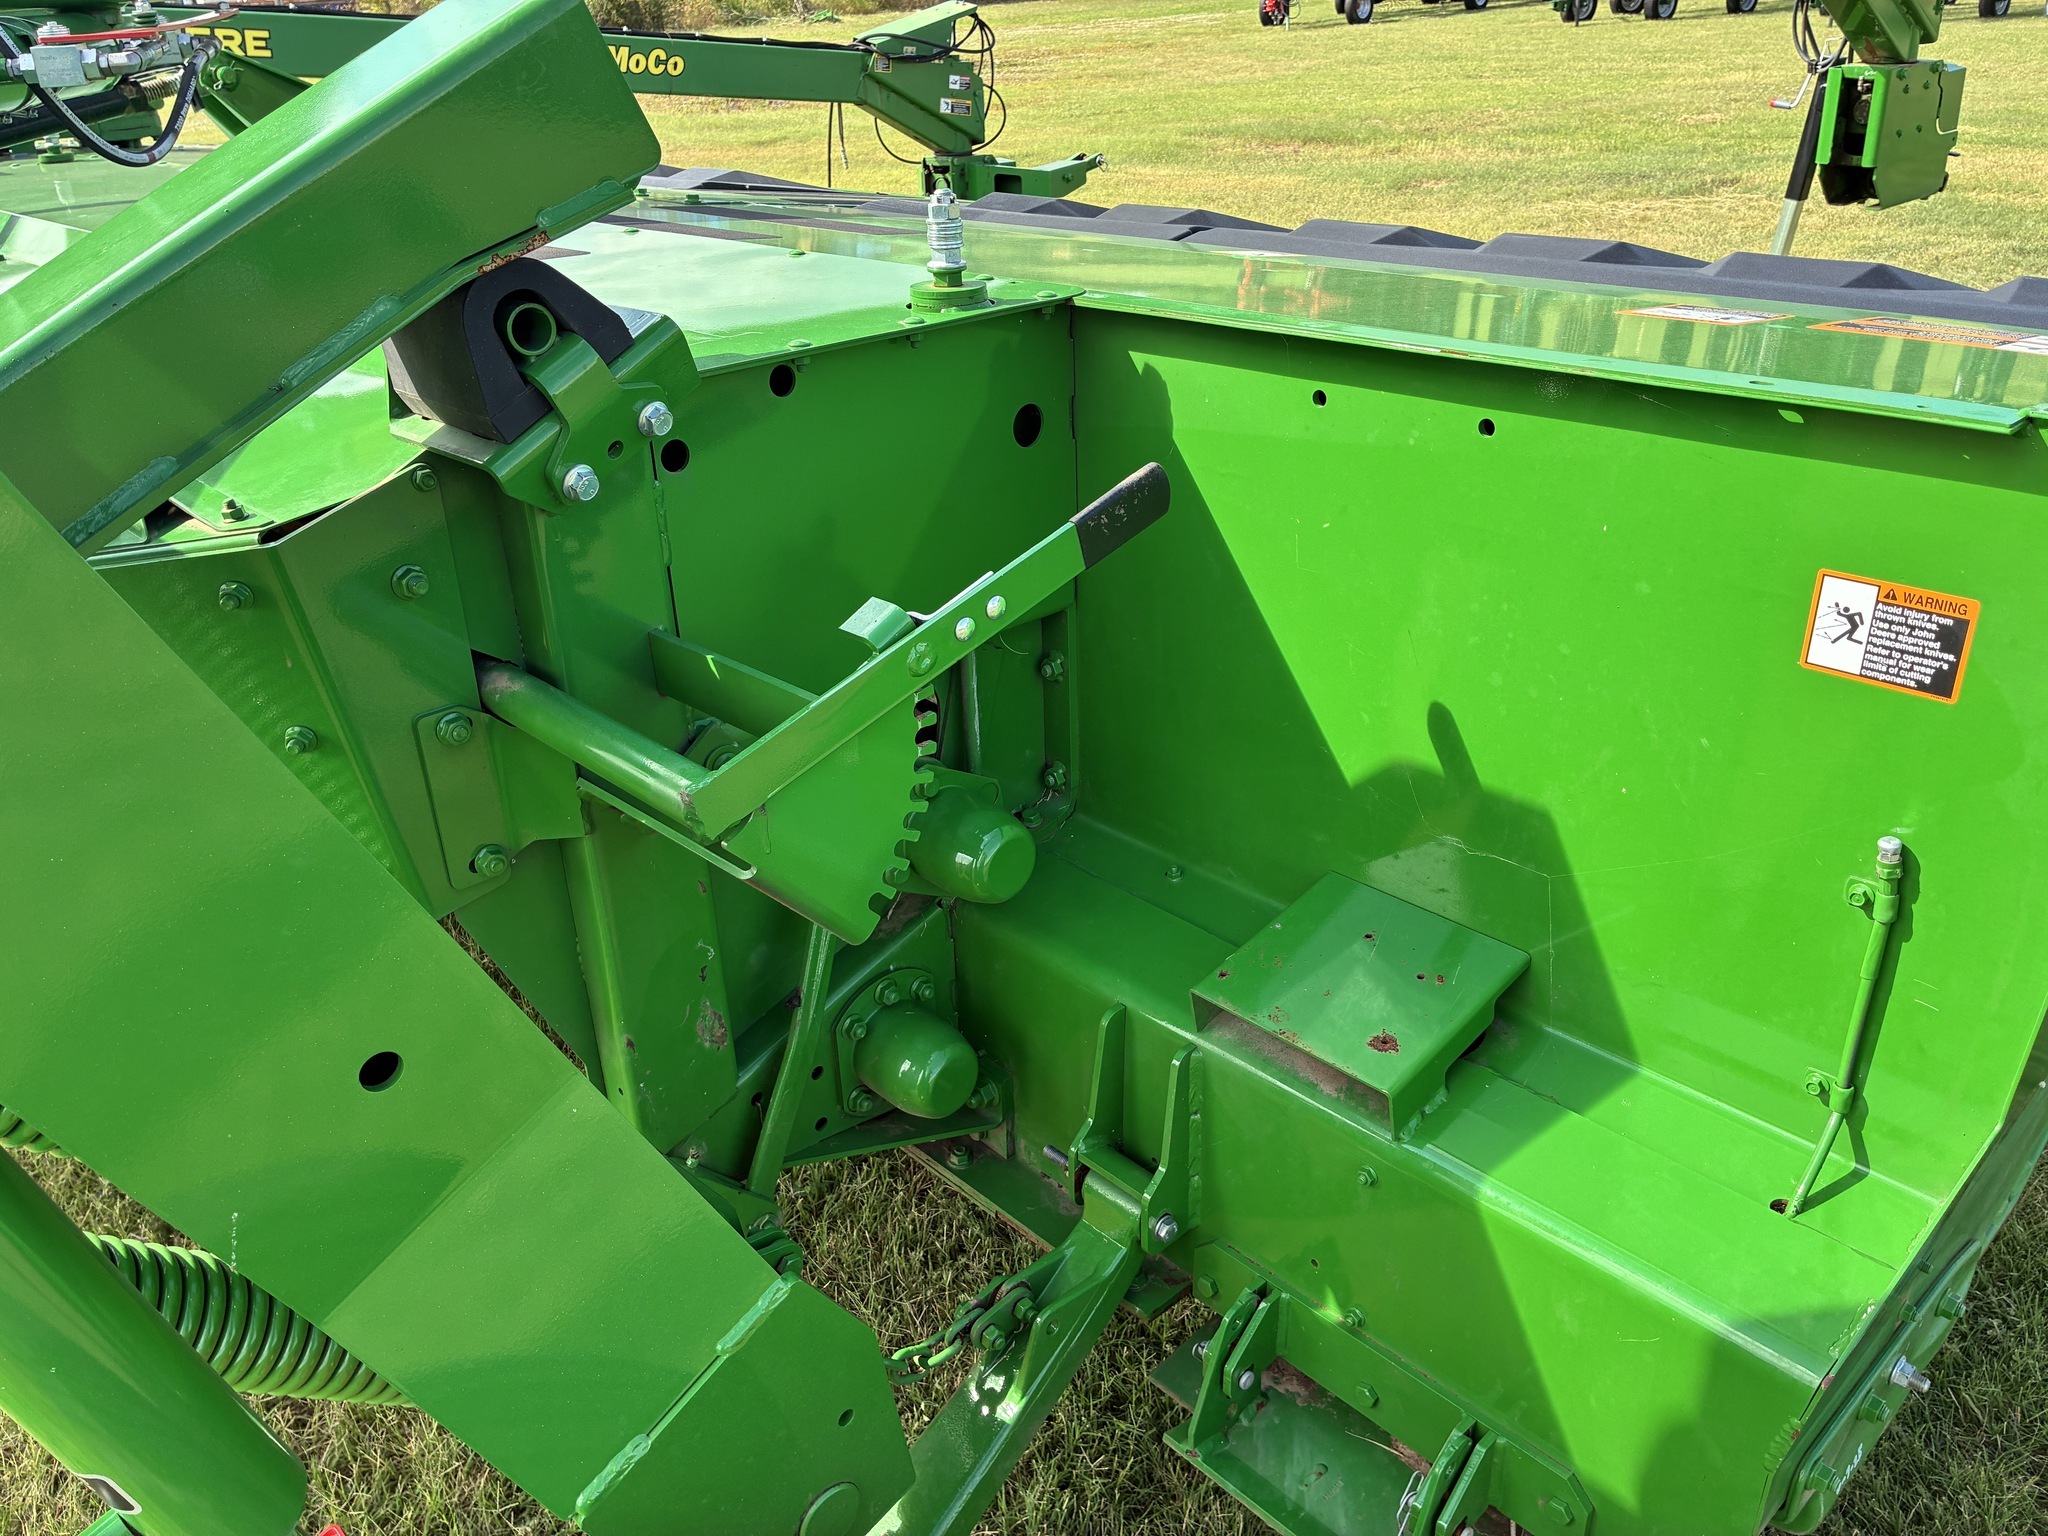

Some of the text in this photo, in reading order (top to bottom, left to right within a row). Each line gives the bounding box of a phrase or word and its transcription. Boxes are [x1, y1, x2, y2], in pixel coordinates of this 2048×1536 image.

[607, 45, 685, 76] MoCo
[1876, 602, 1954, 626] Avoid injury from
[1904, 592, 1968, 616] WARNING
[1872, 619, 1936, 640] Use only John
[1875, 610, 1939, 631] thrown knives.
[1868, 636, 1957, 662] replacement knives.
[1870, 627, 1941, 650] Deere approved
[1864, 653, 1936, 675] manual for wear
[1866, 643, 1949, 670] Refer to operator's
[1861, 669, 1918, 688] components.
[1863, 660, 1931, 684] limits of cutting
